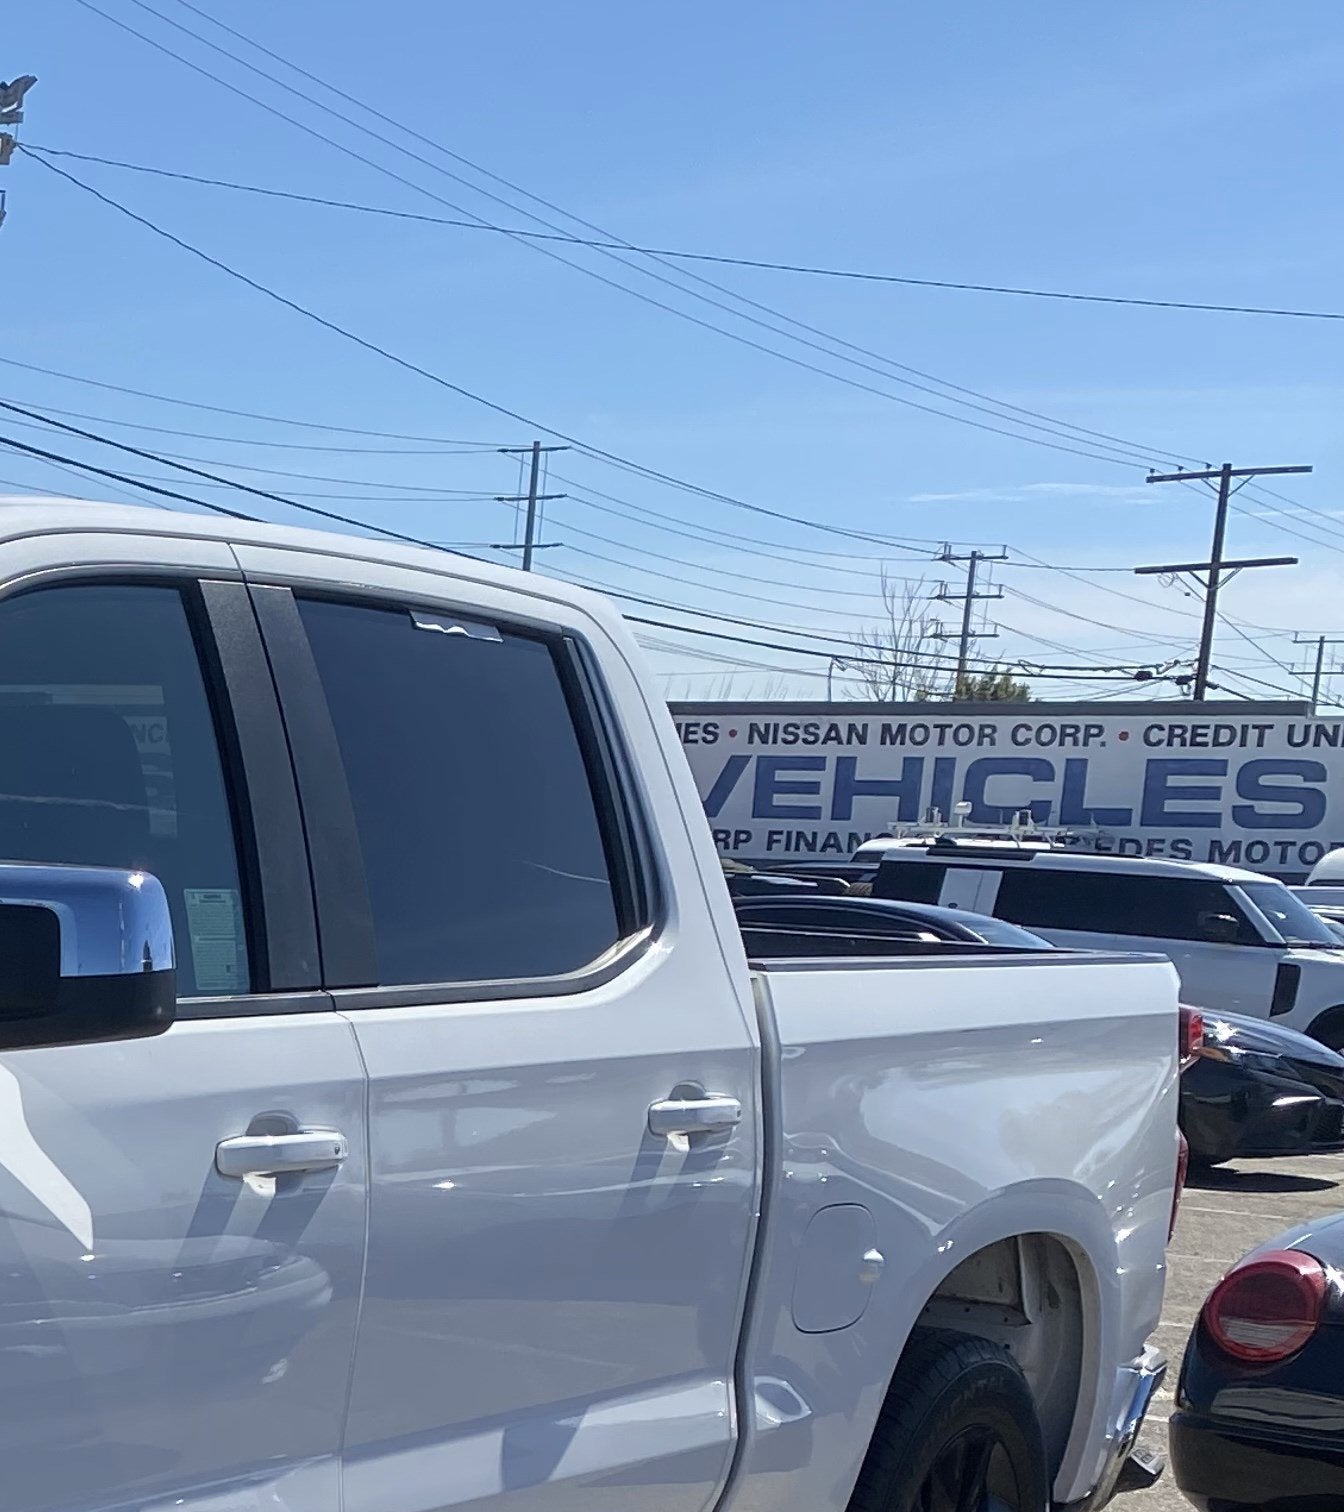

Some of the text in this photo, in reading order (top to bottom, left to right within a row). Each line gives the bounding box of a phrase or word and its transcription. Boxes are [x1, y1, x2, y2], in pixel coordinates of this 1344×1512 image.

[747, 722, 869, 746] NISSAN
[879, 723, 998, 747] MOTOR
[1010, 723, 1108, 747] CORP.
[1143, 723, 1275, 748] CREDIT
[1287, 724, 1344, 748] UN
[703, 755, 1328, 829] VEHICLES
